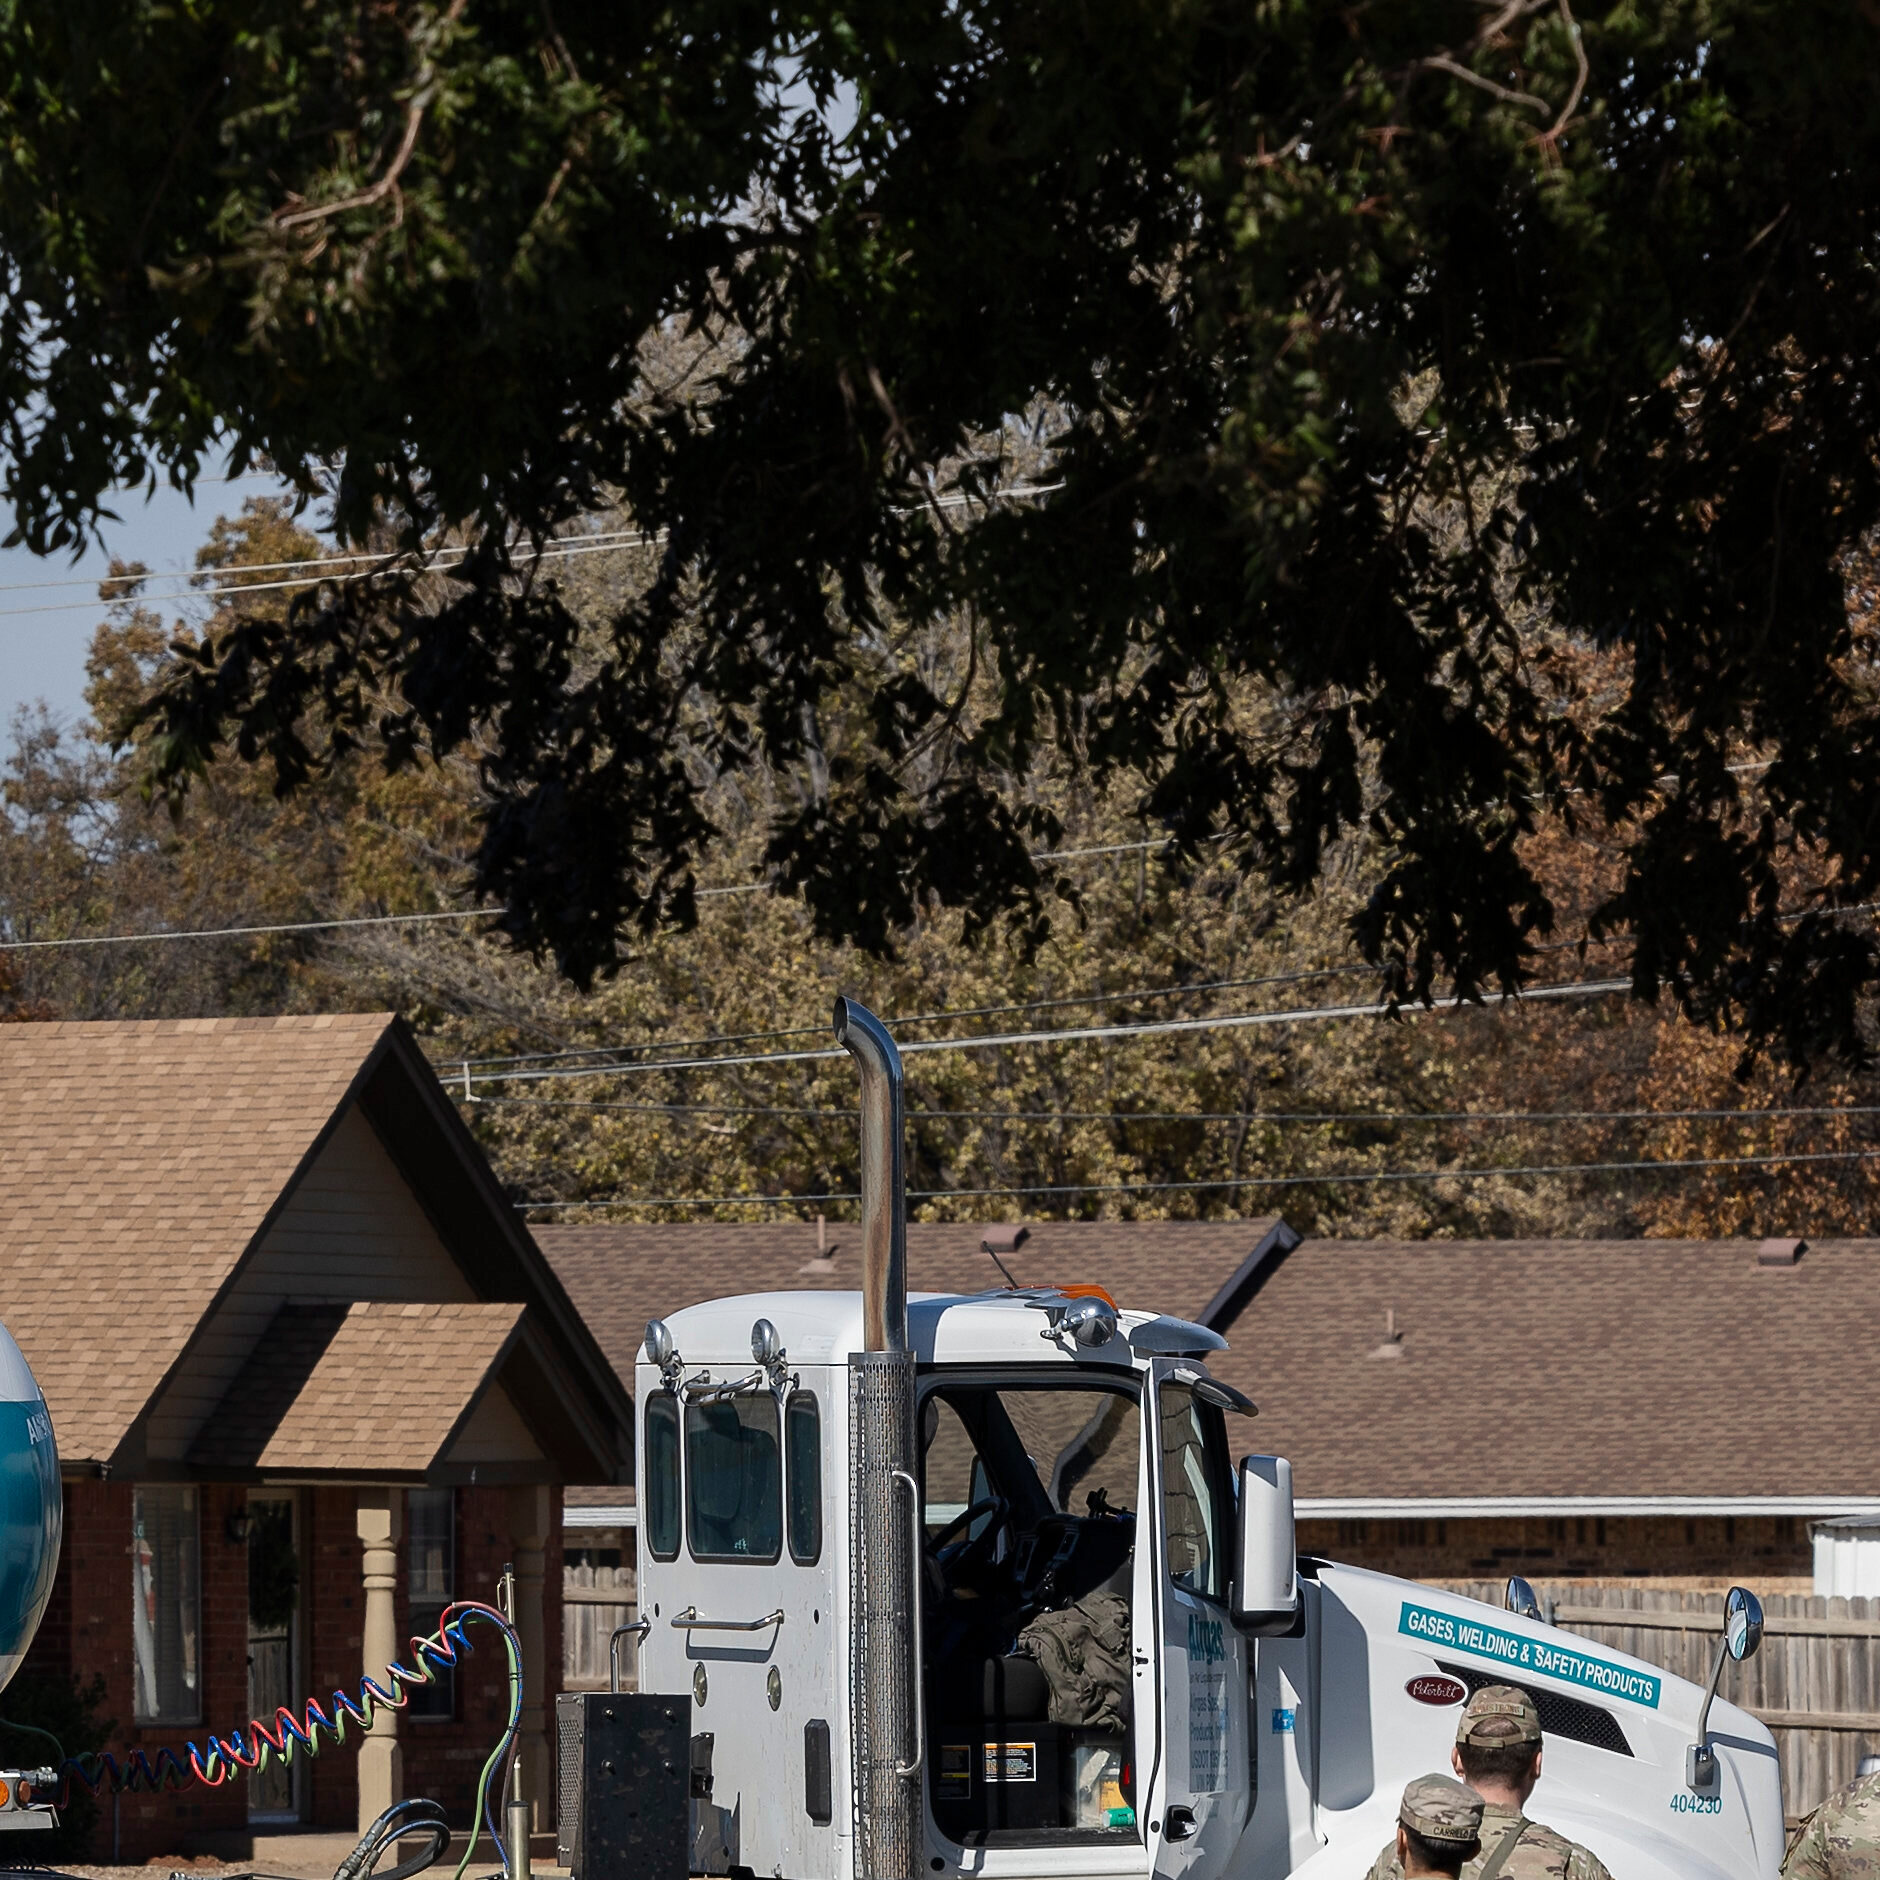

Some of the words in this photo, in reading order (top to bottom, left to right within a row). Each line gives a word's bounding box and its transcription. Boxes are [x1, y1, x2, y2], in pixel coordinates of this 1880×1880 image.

[1408, 1611, 1456, 1645] GASES,
[1458, 1624, 1518, 1660] WELDING
[1520, 1644, 1530, 1663] &
[1534, 1648, 1585, 1679] SAFETY
[1584, 1664, 1653, 1700] PRODUCTS
[1413, 1680, 1460, 1698] Peterbilt
[1670, 1794, 1722, 1815] 404230
